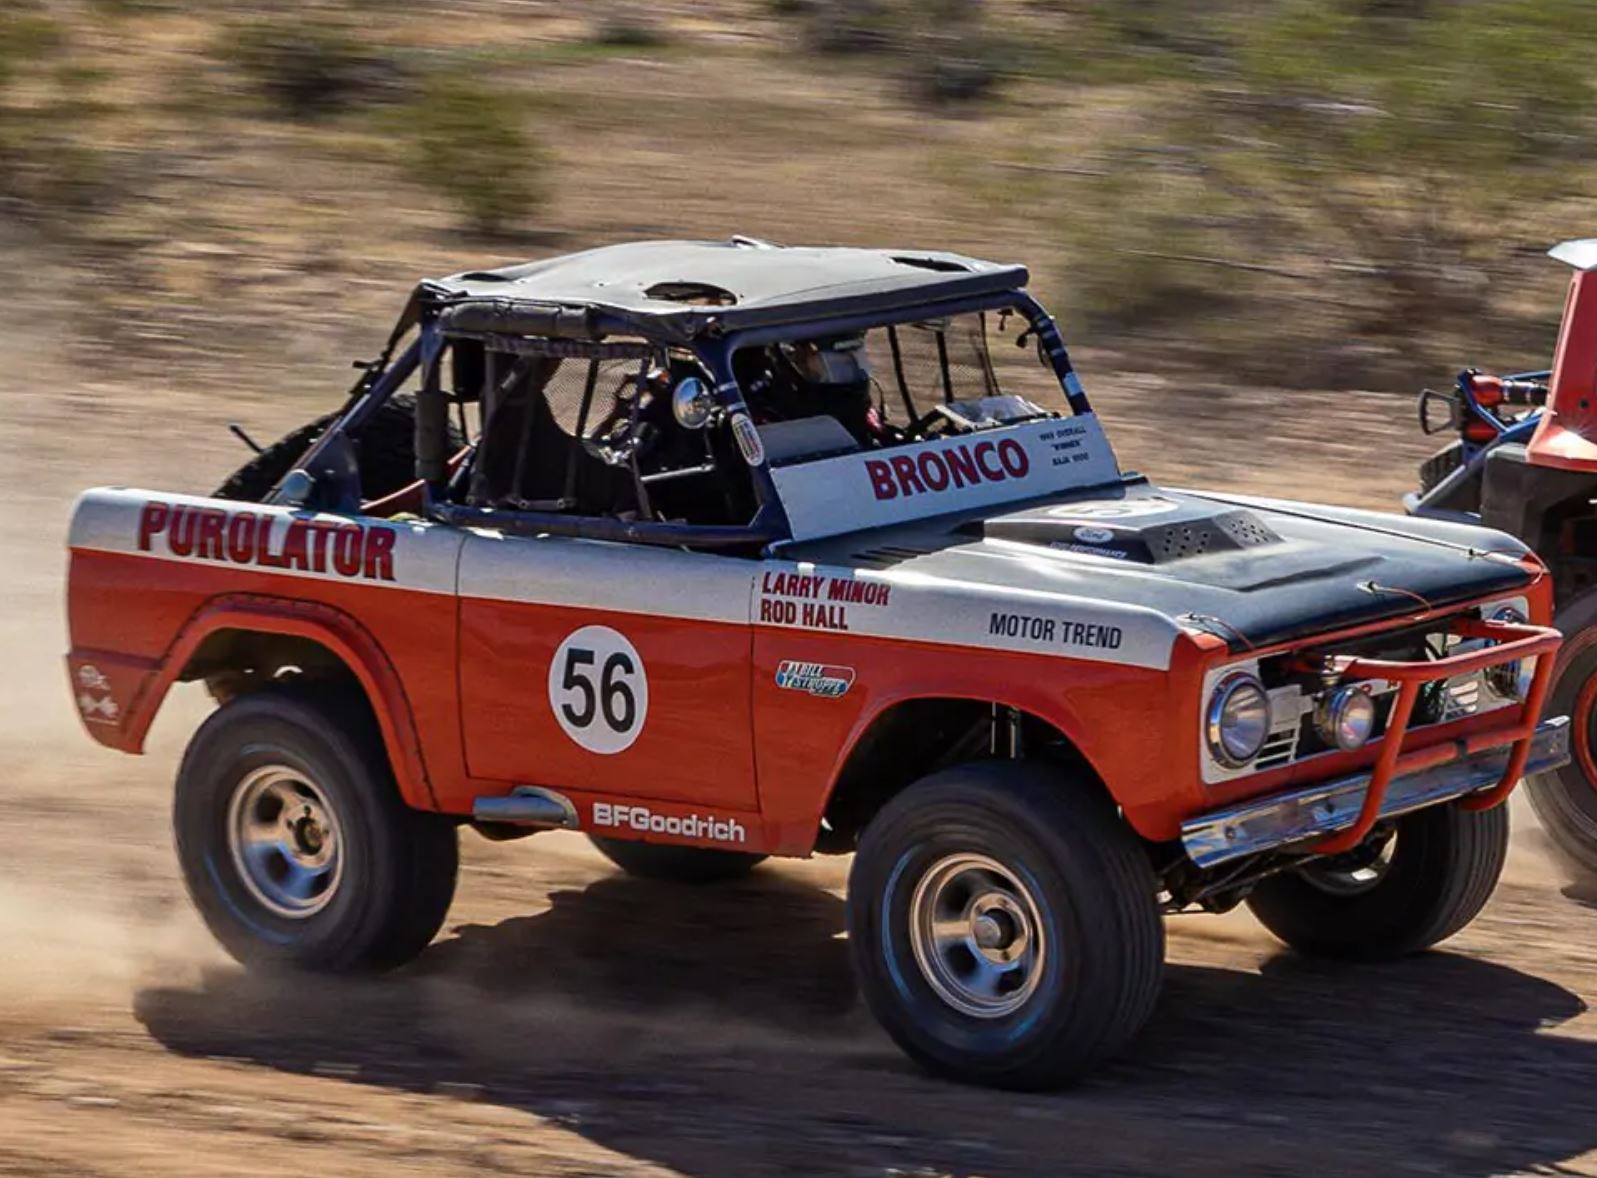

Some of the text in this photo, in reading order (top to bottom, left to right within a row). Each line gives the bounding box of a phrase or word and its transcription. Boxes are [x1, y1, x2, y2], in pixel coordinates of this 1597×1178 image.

[864, 438, 1029, 501] BRONCO
[138, 499, 396, 581] PUROLATOR
[762, 571, 892, 606] LARRY MINOR
[760, 598, 848, 630] ROD HALL
[989, 612, 1122, 650] MOTOR TREND
[561, 647, 636, 734] 56
[592, 802, 746, 843] BFGoodrich
